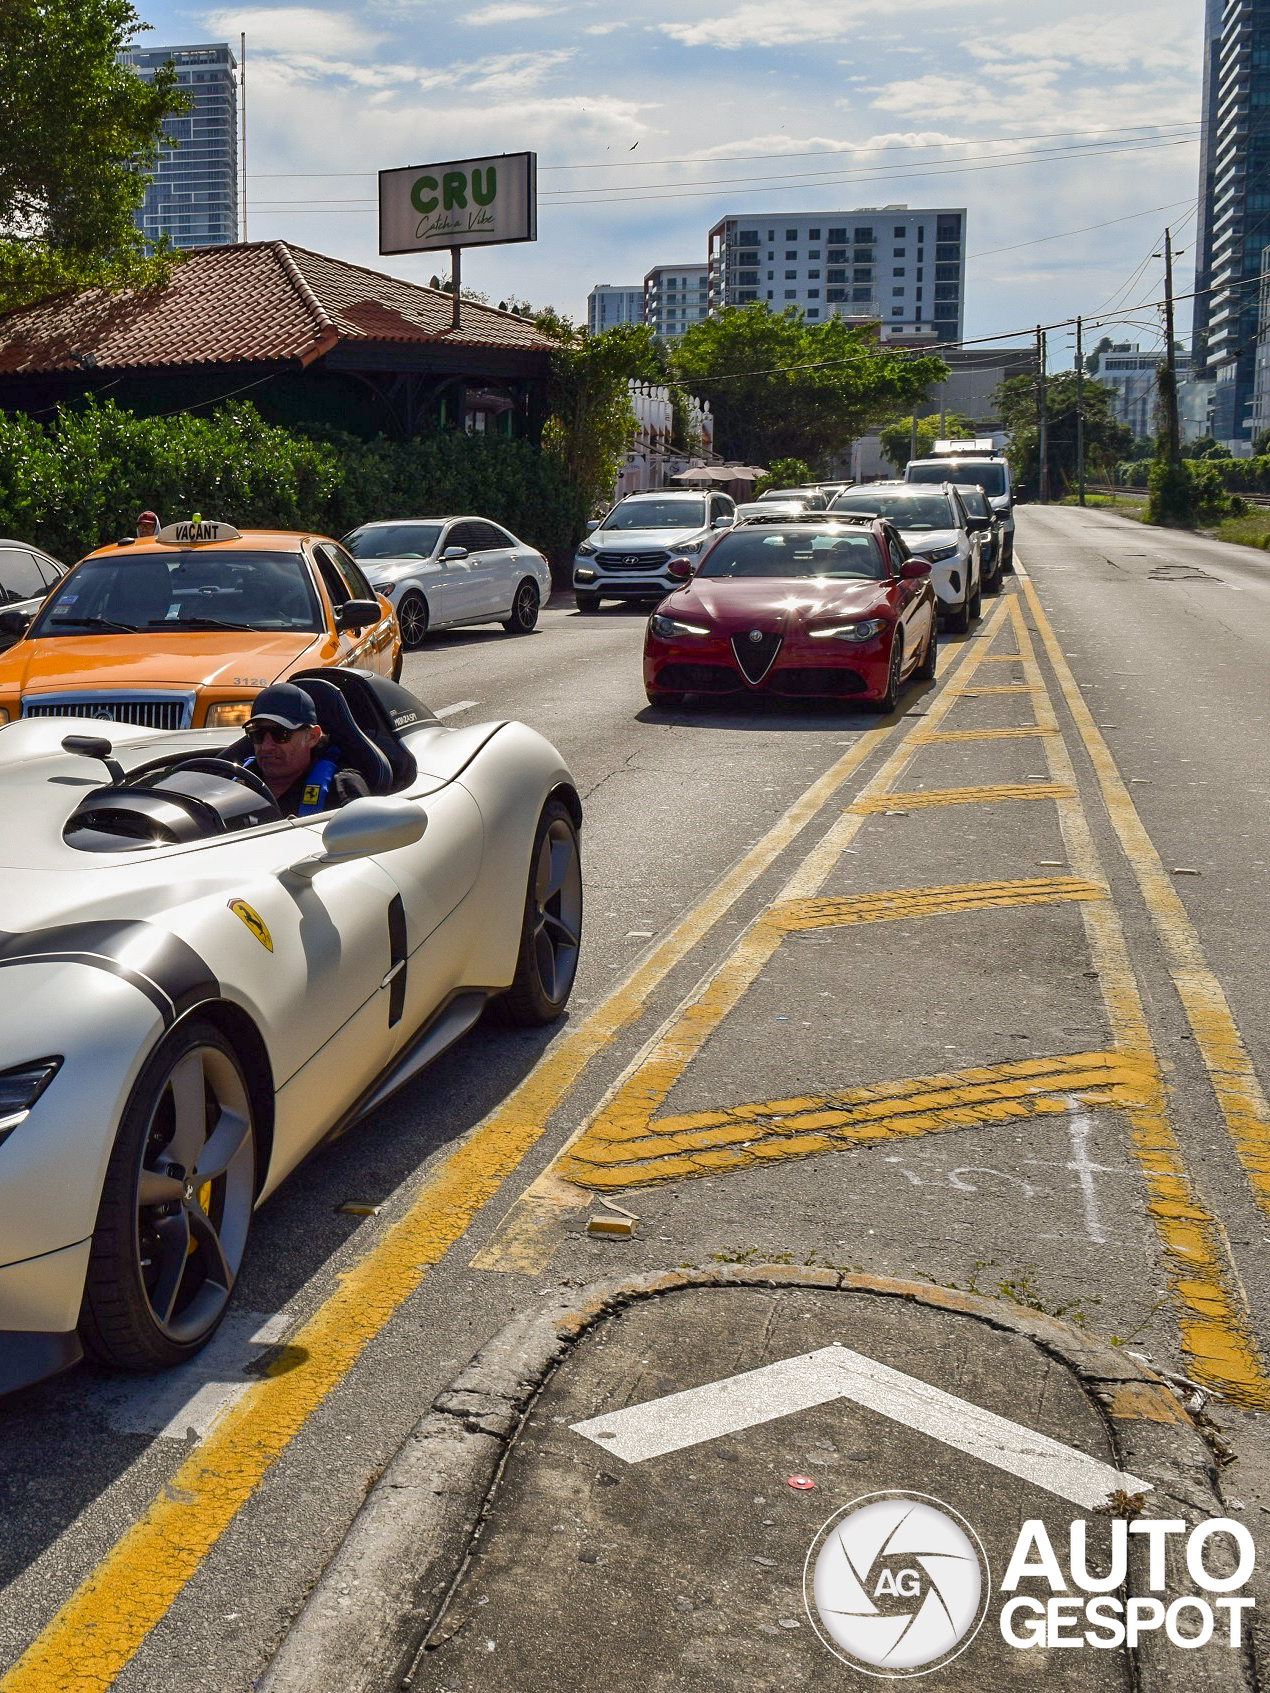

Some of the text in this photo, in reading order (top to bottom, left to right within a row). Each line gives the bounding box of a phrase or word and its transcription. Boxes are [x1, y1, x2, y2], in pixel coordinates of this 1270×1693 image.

[411, 167, 497, 214] CRU
[415, 214, 452, 239] Catch
[468, 208, 496, 230] Vibe
[176, 524, 219, 540] VACANT
[233, 677, 267, 686] 3126
